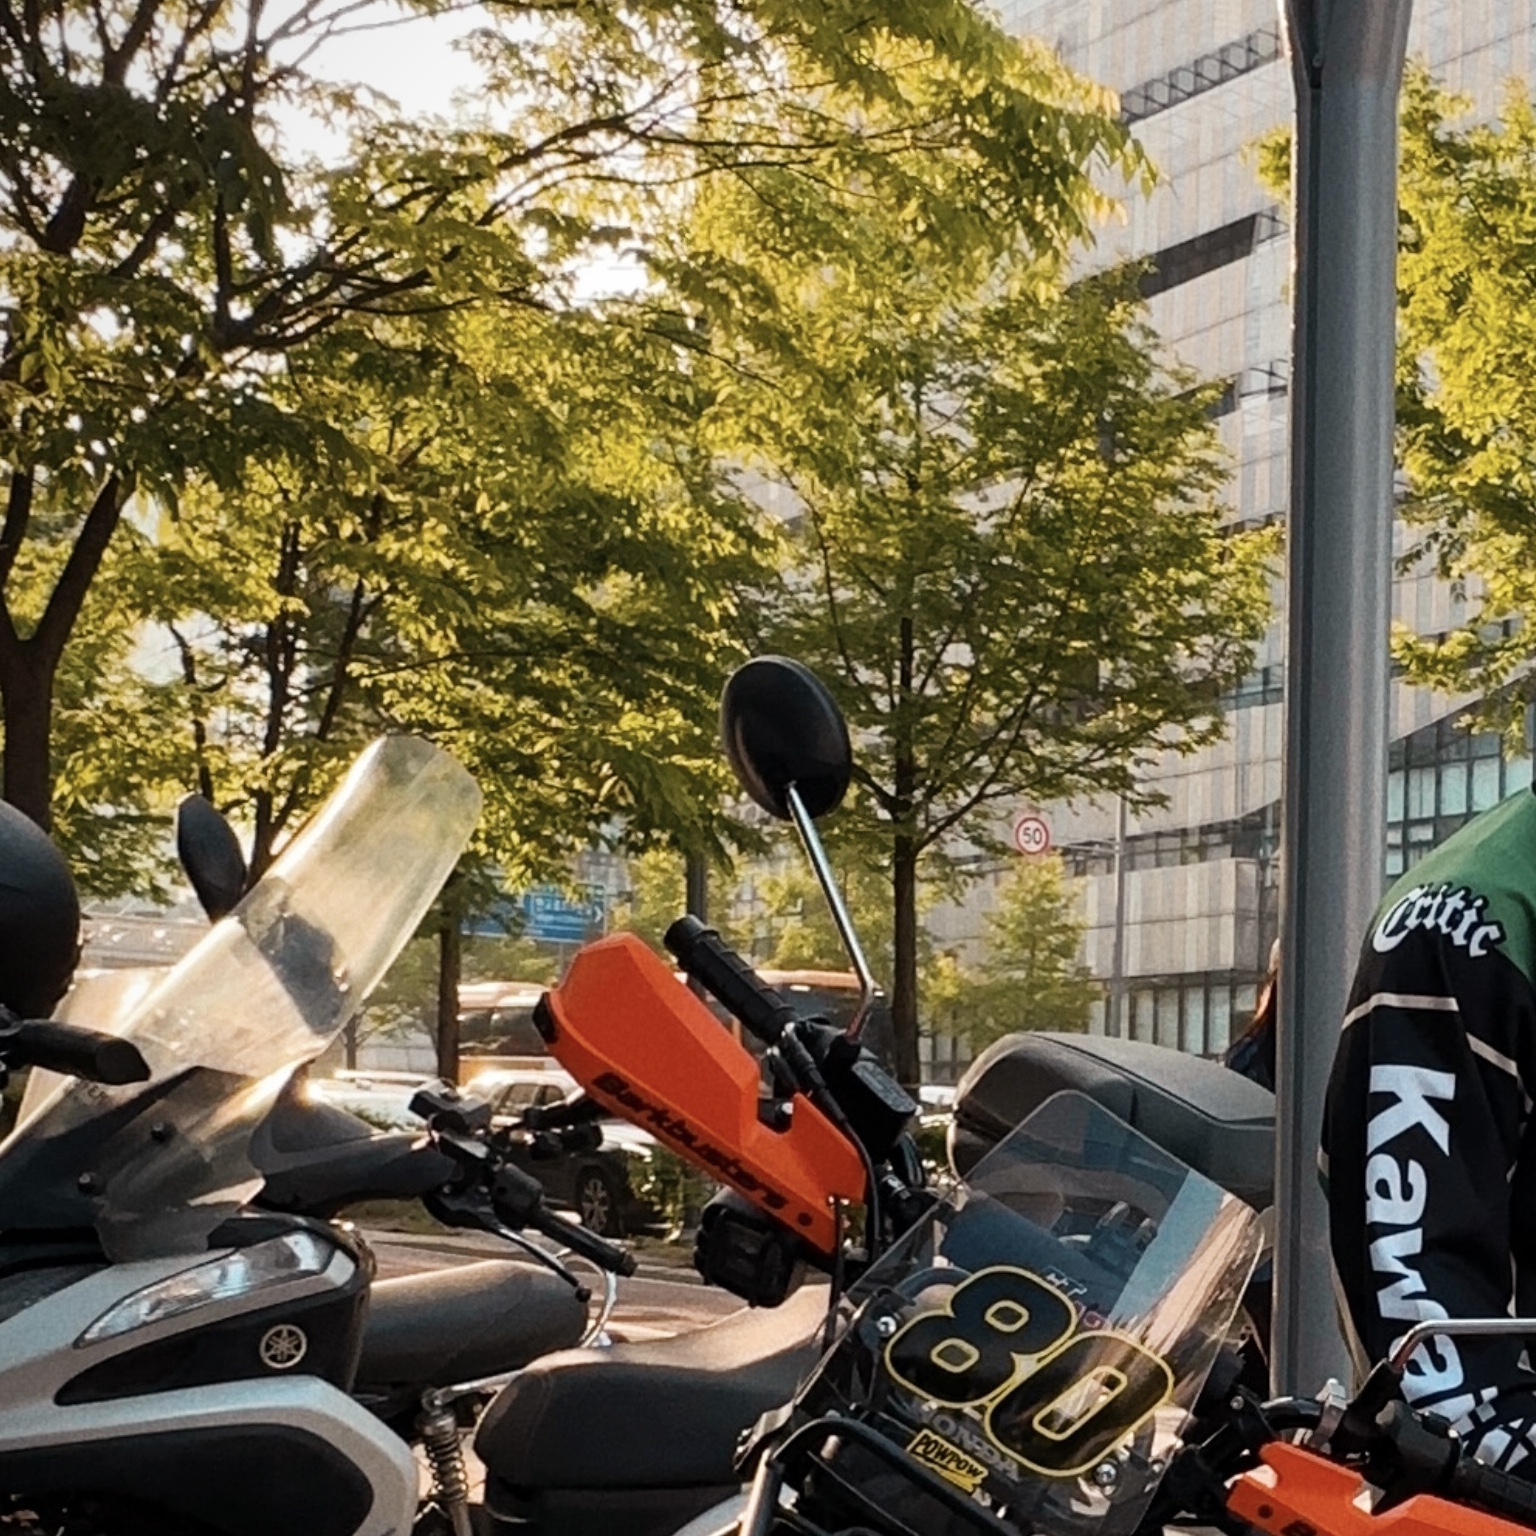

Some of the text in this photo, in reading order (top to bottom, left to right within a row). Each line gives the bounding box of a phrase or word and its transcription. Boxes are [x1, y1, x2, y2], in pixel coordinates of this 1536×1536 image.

[1022, 826, 1042, 845] 50
[1373, 883, 1501, 957] Critic
[884, 1265, 1174, 1477] 80
[914, 1432, 987, 1482] POWPOW
